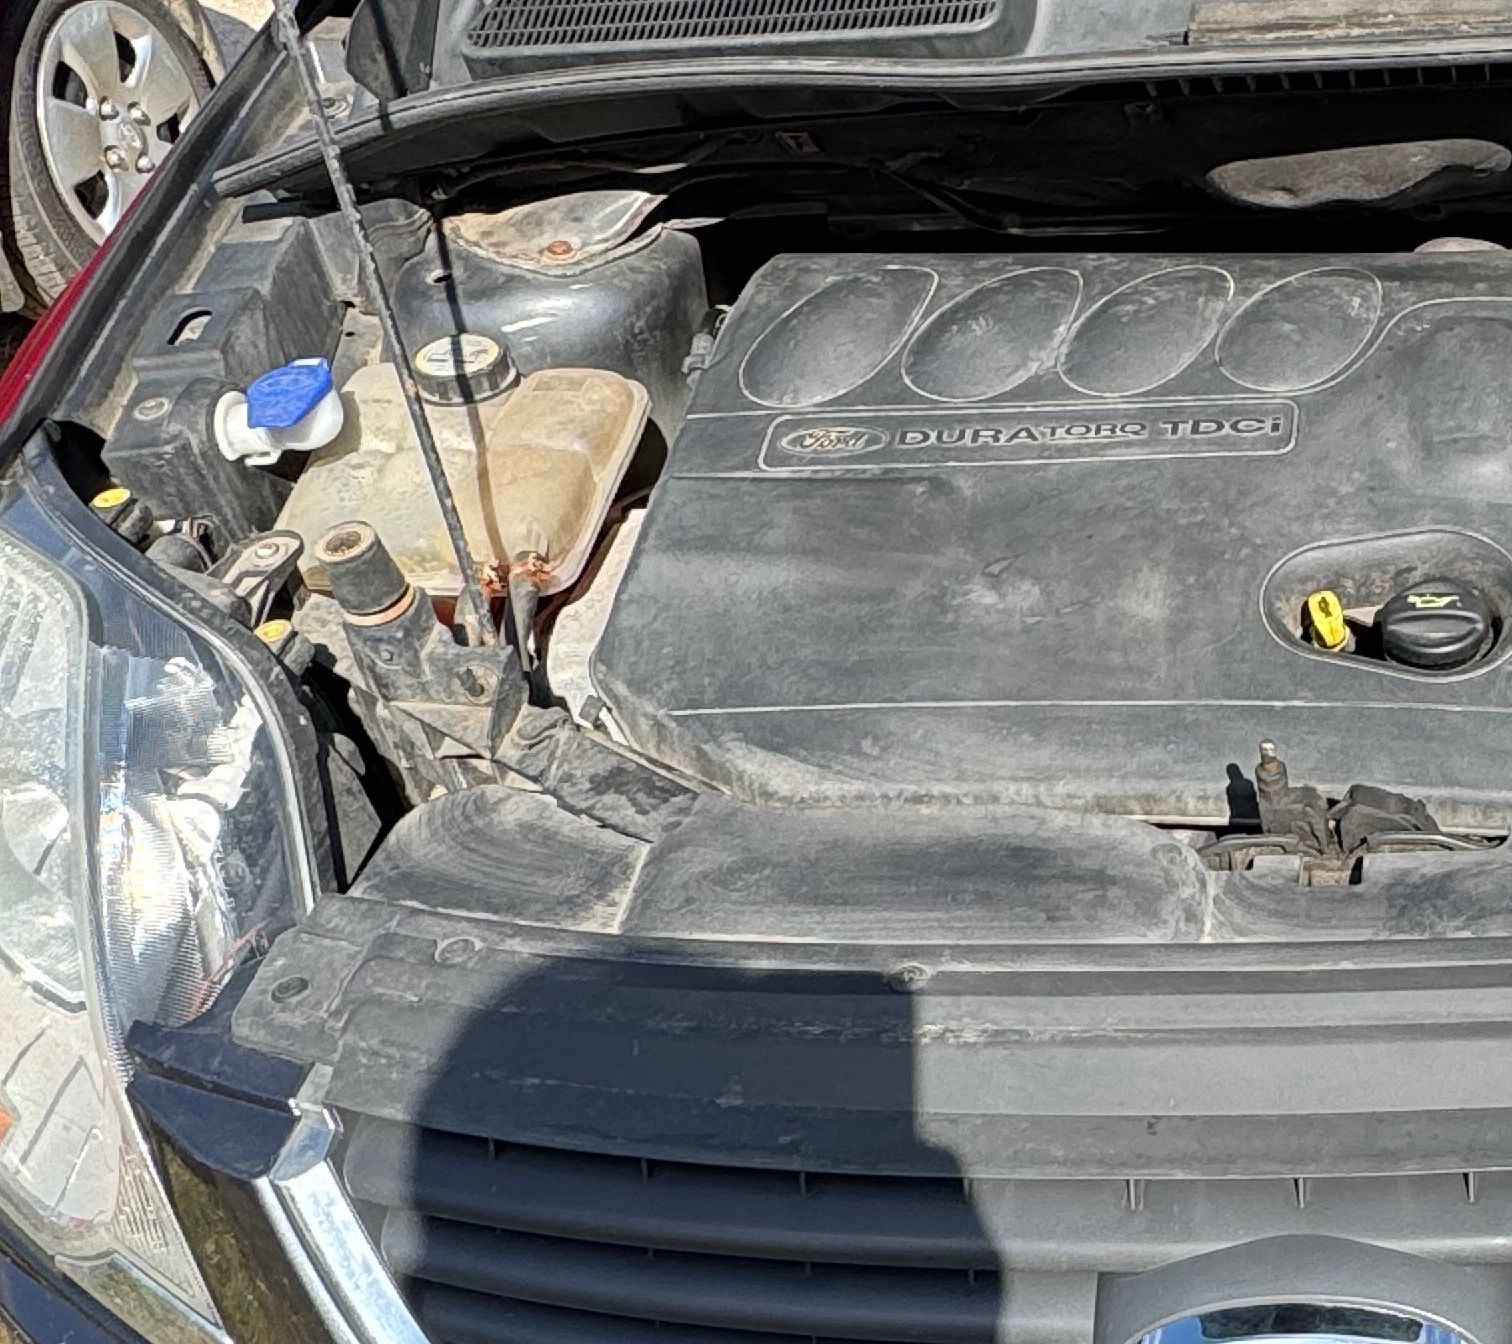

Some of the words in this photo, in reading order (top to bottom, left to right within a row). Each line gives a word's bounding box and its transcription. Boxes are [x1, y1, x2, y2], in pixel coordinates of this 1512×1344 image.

[800, 424, 868, 449] Ford
[899, 422, 1147, 446] DURATORQ
[1163, 415, 1283, 436] TDCi
